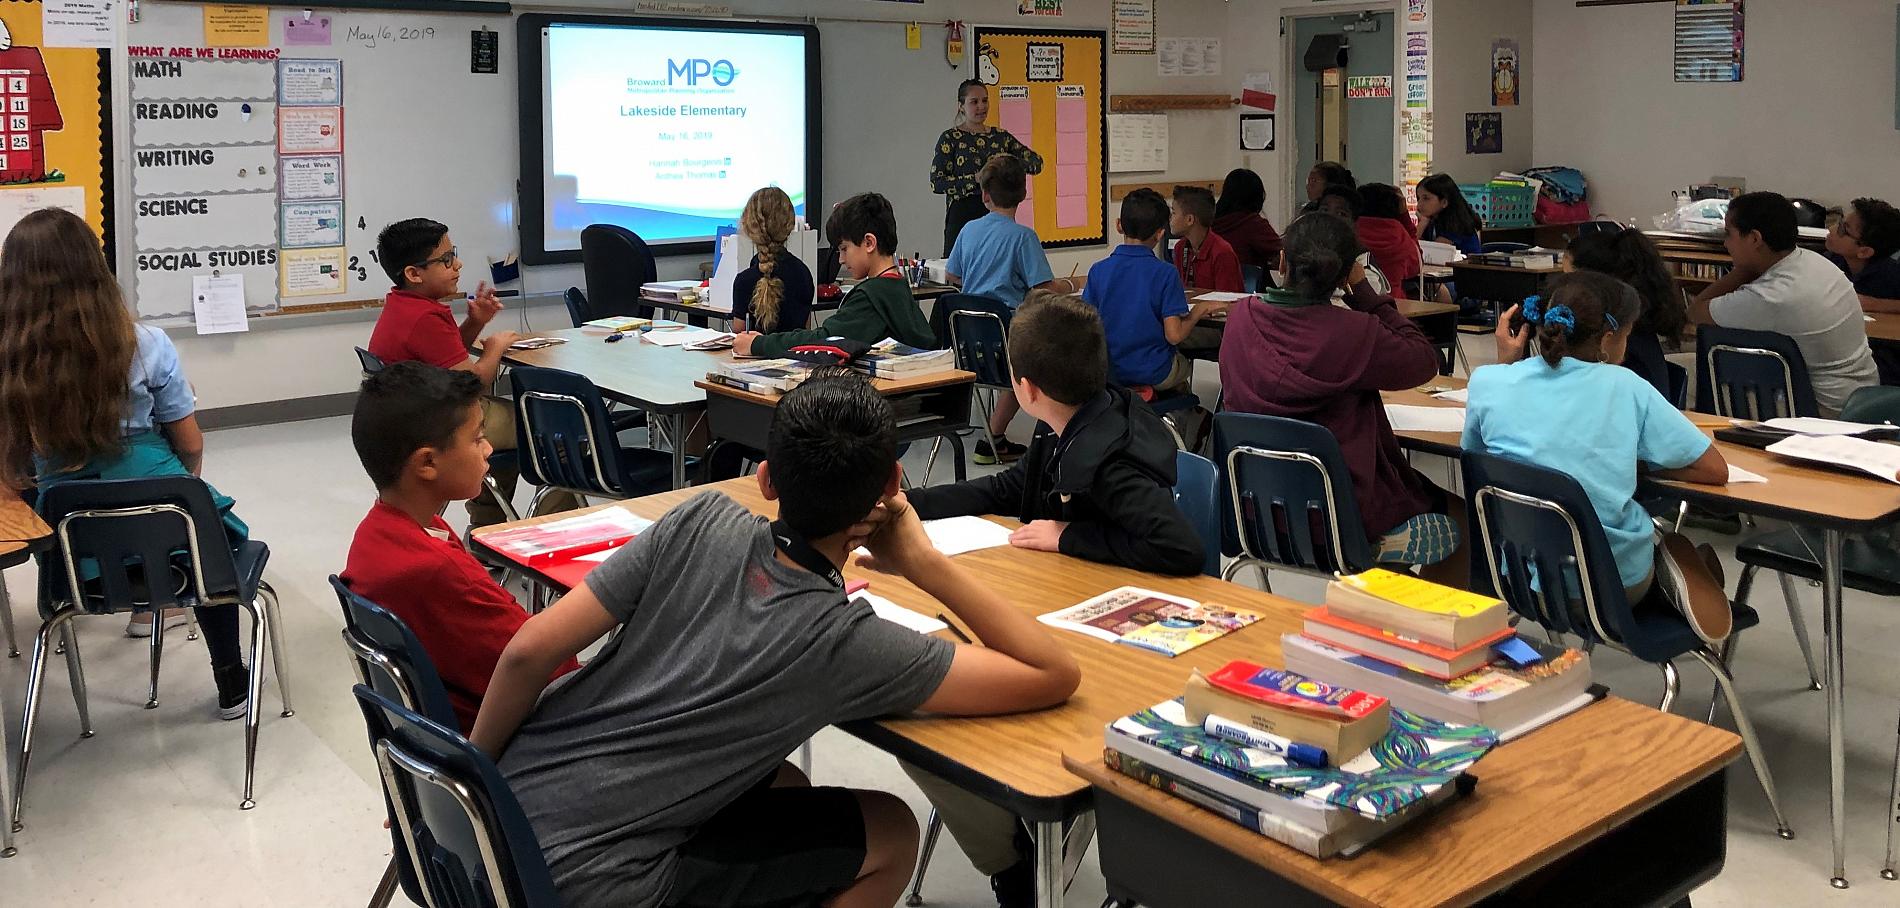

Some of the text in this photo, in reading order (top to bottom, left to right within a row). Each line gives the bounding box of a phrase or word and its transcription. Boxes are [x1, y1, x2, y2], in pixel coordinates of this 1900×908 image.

[346, 25, 436, 48] May 16, 2019
[128, 46, 281, 60] WHAT ARE WE LEARNING?
[134, 60, 182, 78] MATH
[667, 58, 735, 86] MPO
[14, 80, 22, 91] 4
[626, 78, 667, 87] Broward
[1348, 77, 1370, 87] WALK
[1348, 88, 1391, 97] DON'T RUN
[15, 100, 25, 111] 11
[136, 103, 219, 120] READING
[620, 105, 748, 118] Lakeside Elementary
[13, 119, 26, 129] 18
[13, 138, 28, 148] 25
[658, 132, 675, 141] May
[693, 131, 713, 140] 2019
[137, 149, 214, 168] WRITING
[139, 198, 208, 217] SCIENCE
[293, 208, 332, 216] Computers
[357, 215, 367, 231] 4
[138, 249, 277, 271] SOCIAL STUDIES
[368, 249, 378, 263] 1
[348, 256, 359, 271] 2
[357, 266, 367, 281] 3
